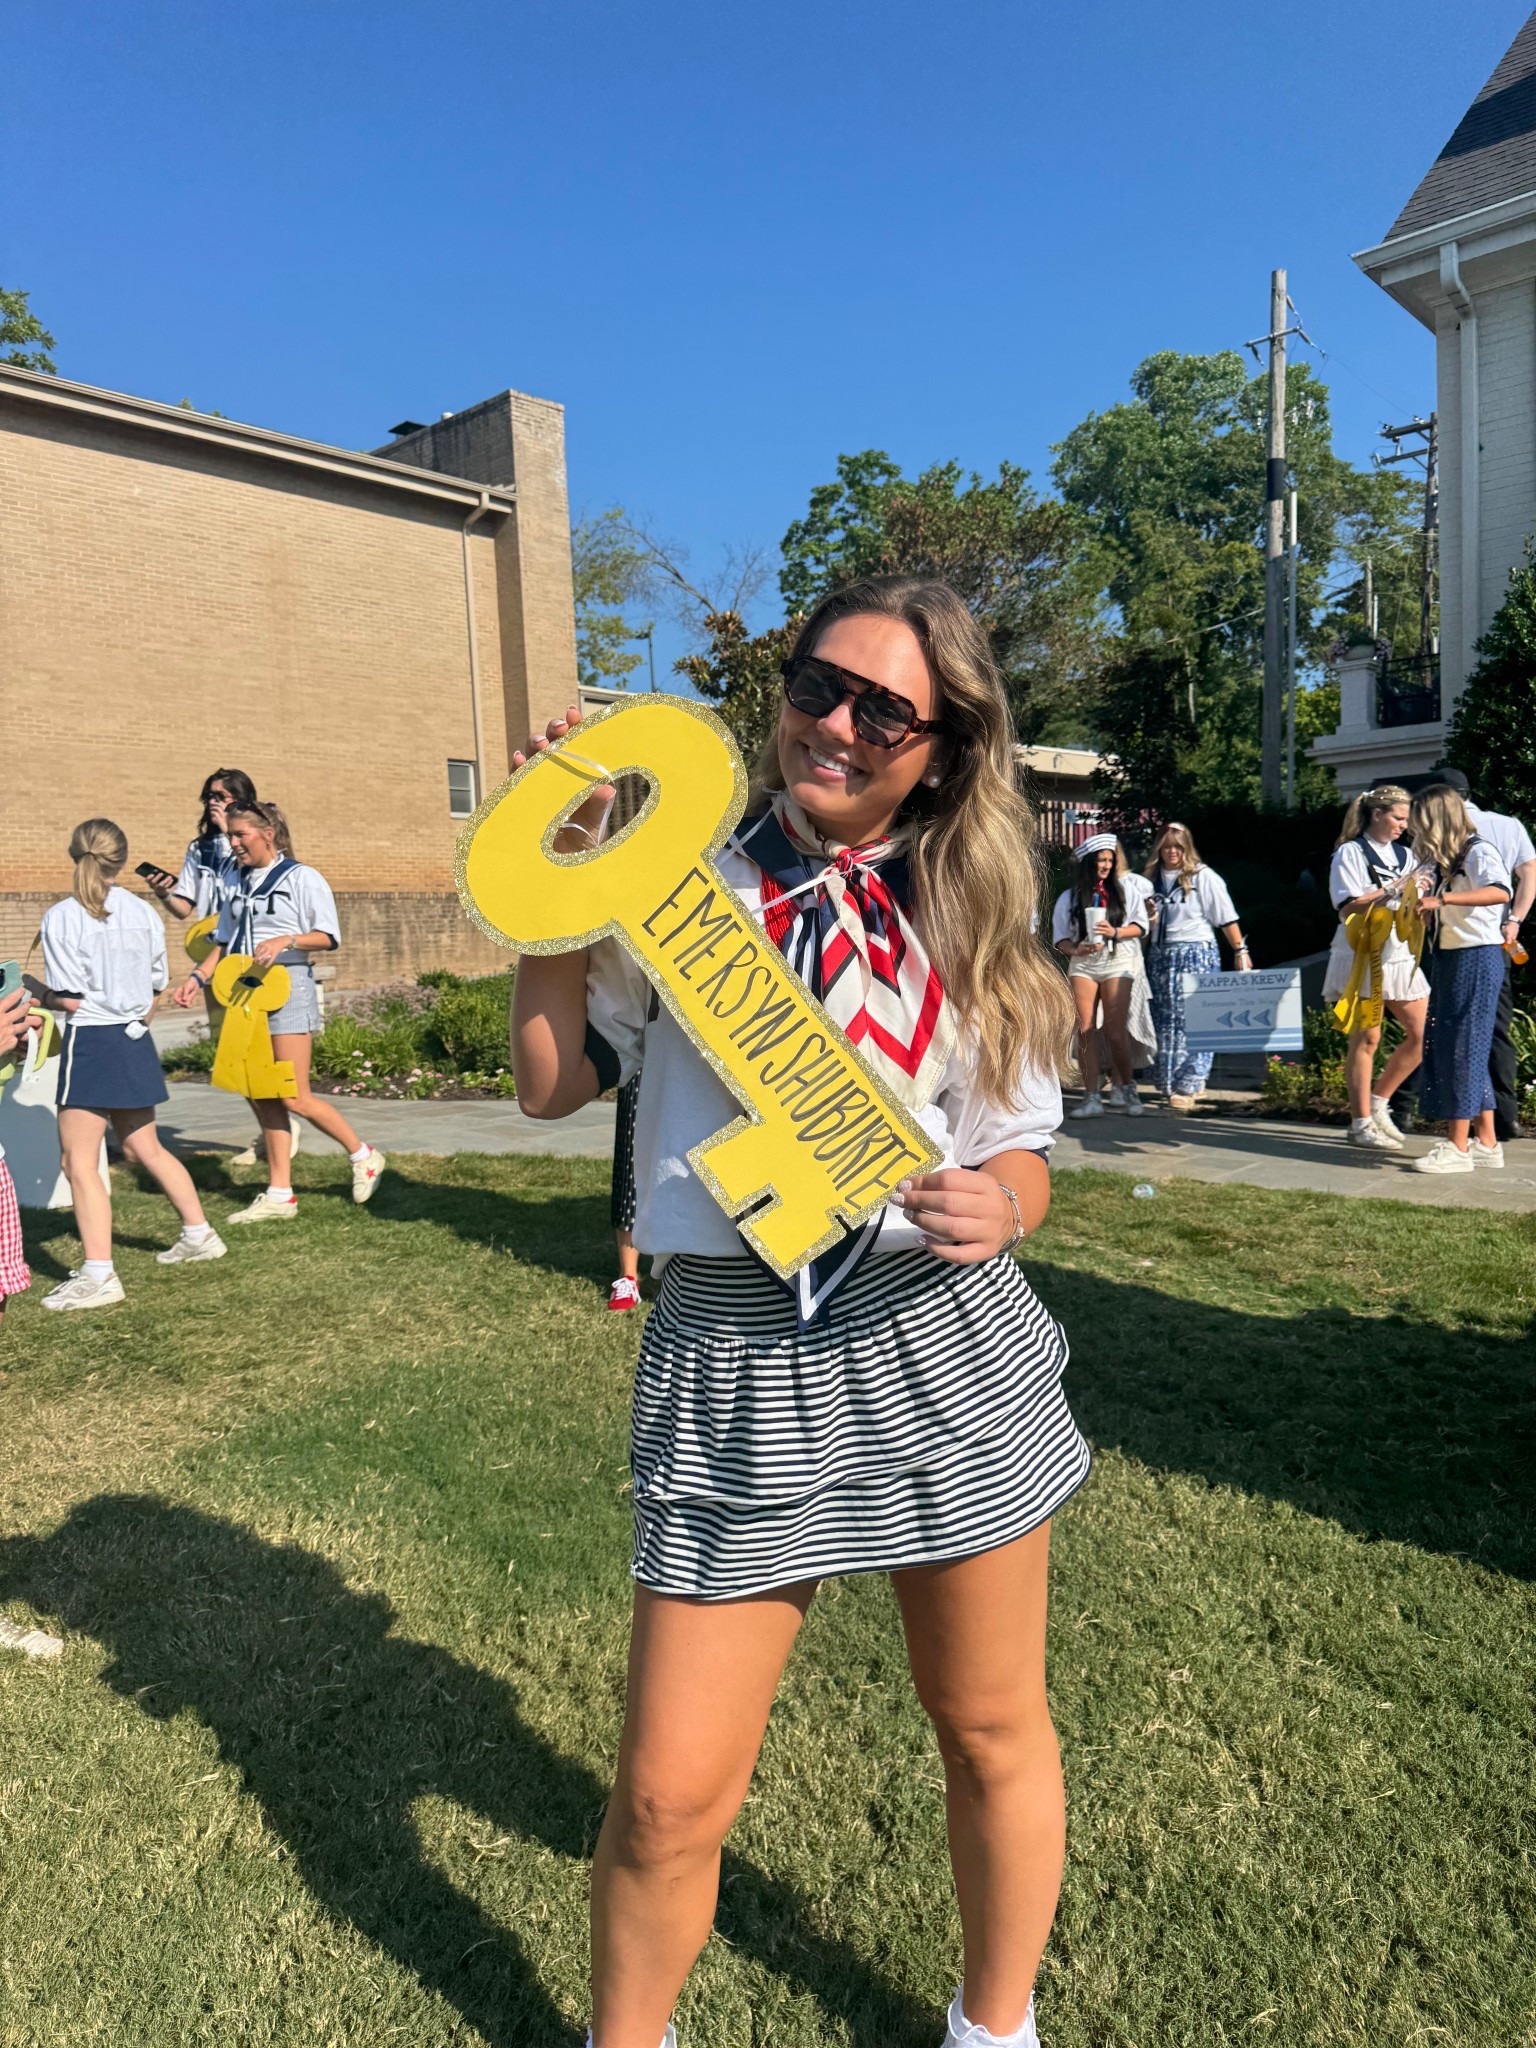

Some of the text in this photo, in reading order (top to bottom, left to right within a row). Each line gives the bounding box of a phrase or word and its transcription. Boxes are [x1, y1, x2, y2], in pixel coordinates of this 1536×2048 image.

[641, 866, 922, 1211] EMERSYN SHUBURTE
[1251, 973, 1288, 986] KREW
